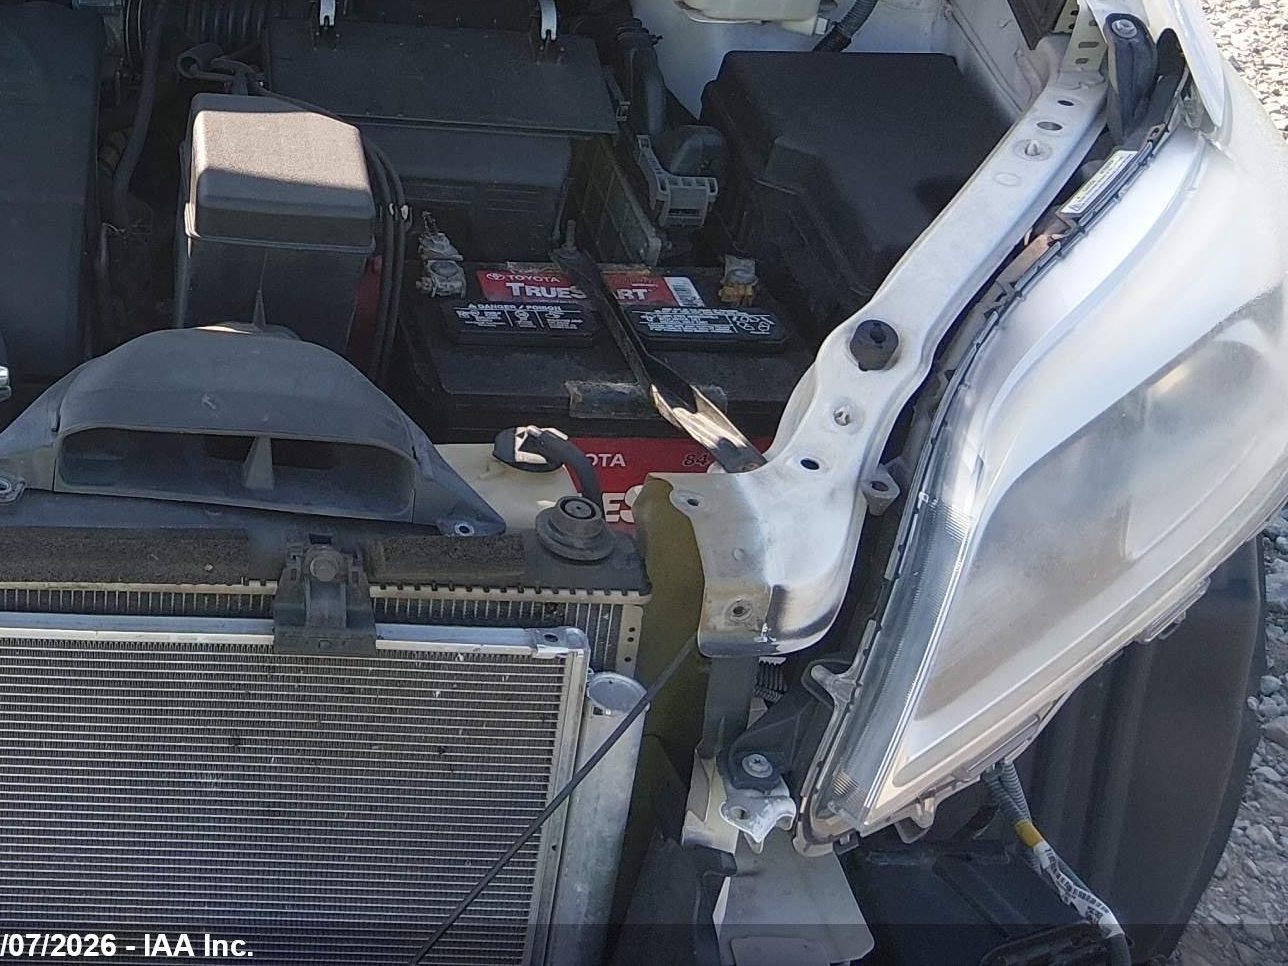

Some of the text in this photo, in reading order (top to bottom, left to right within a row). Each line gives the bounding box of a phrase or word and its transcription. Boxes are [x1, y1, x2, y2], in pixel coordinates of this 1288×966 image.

[507, 274, 561, 283] TOYOTA
[585, 453, 709, 467] OTA 84
